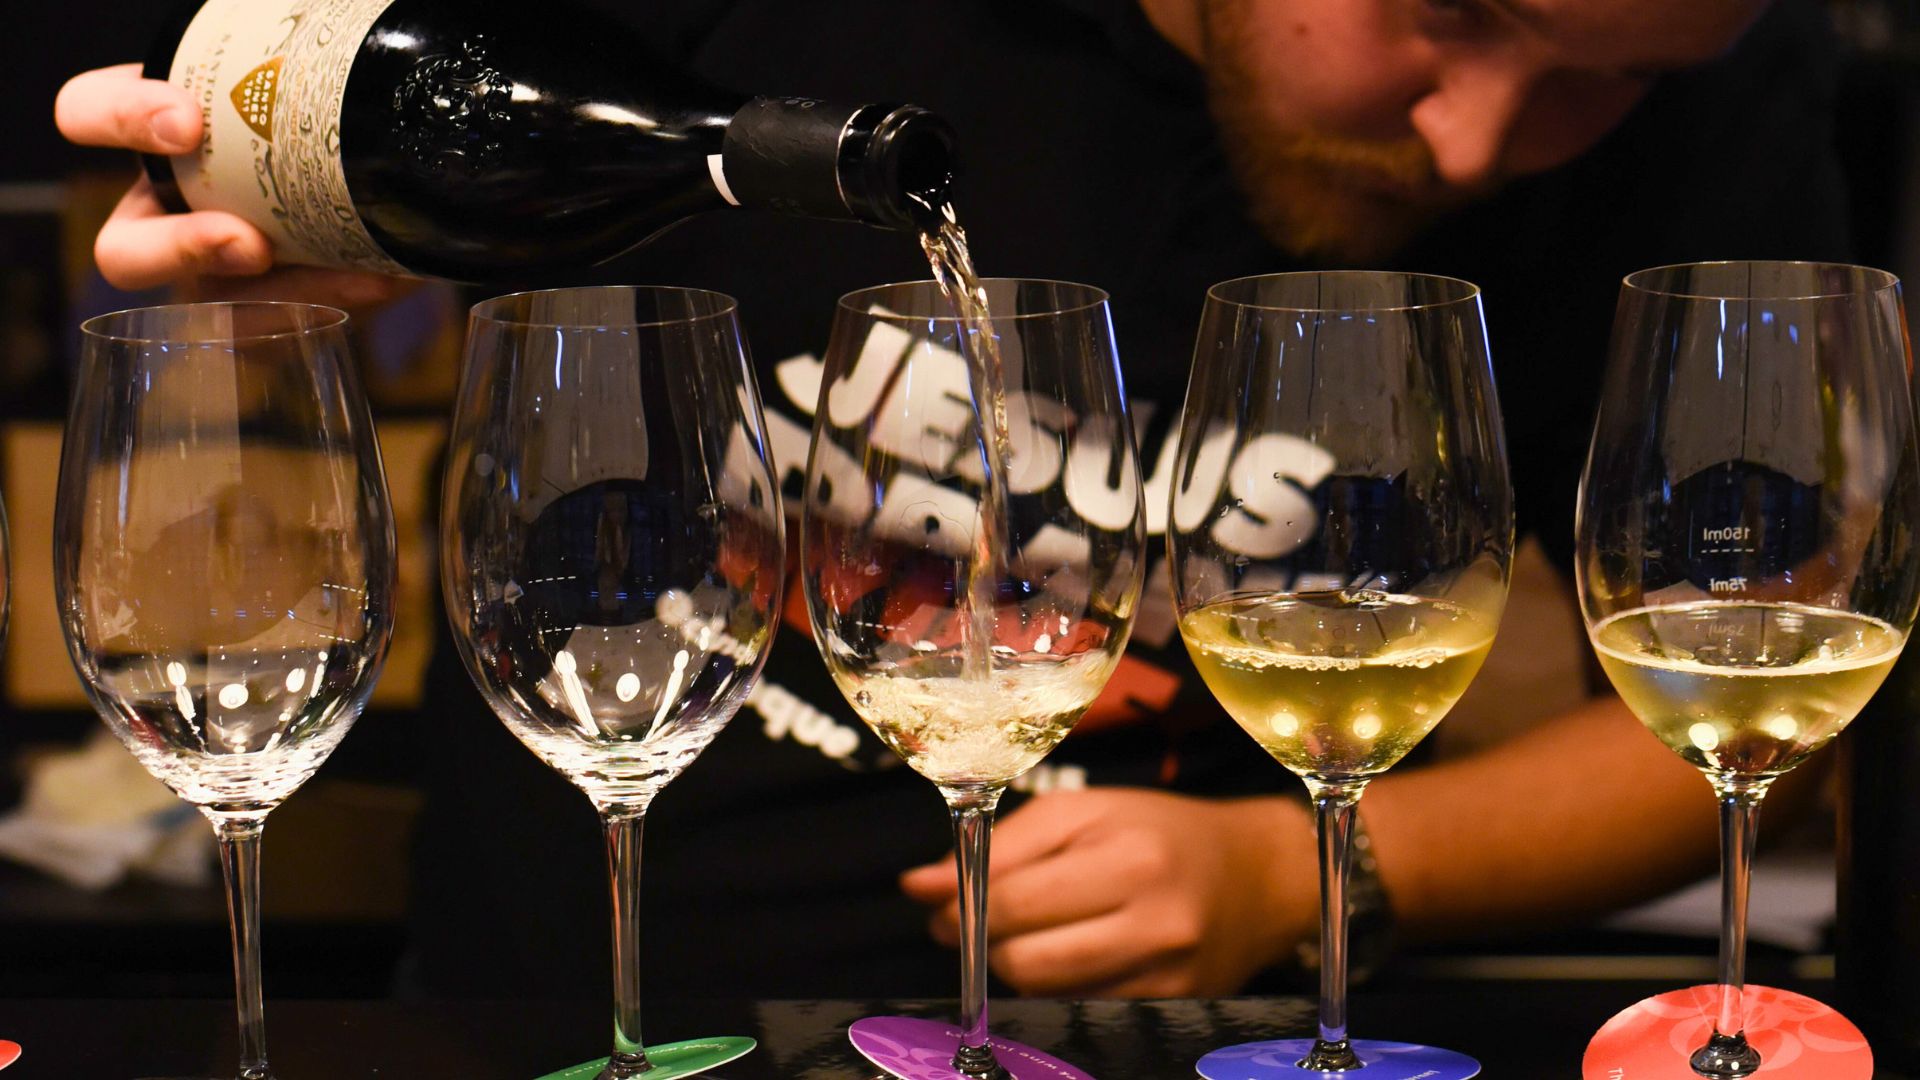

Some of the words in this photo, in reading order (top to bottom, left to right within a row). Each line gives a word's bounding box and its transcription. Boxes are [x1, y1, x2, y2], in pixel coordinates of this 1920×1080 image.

[250, 70, 265, 124] WINES
[259, 69, 275, 126] SANTO
[774, 304, 1337, 560] JESUS
